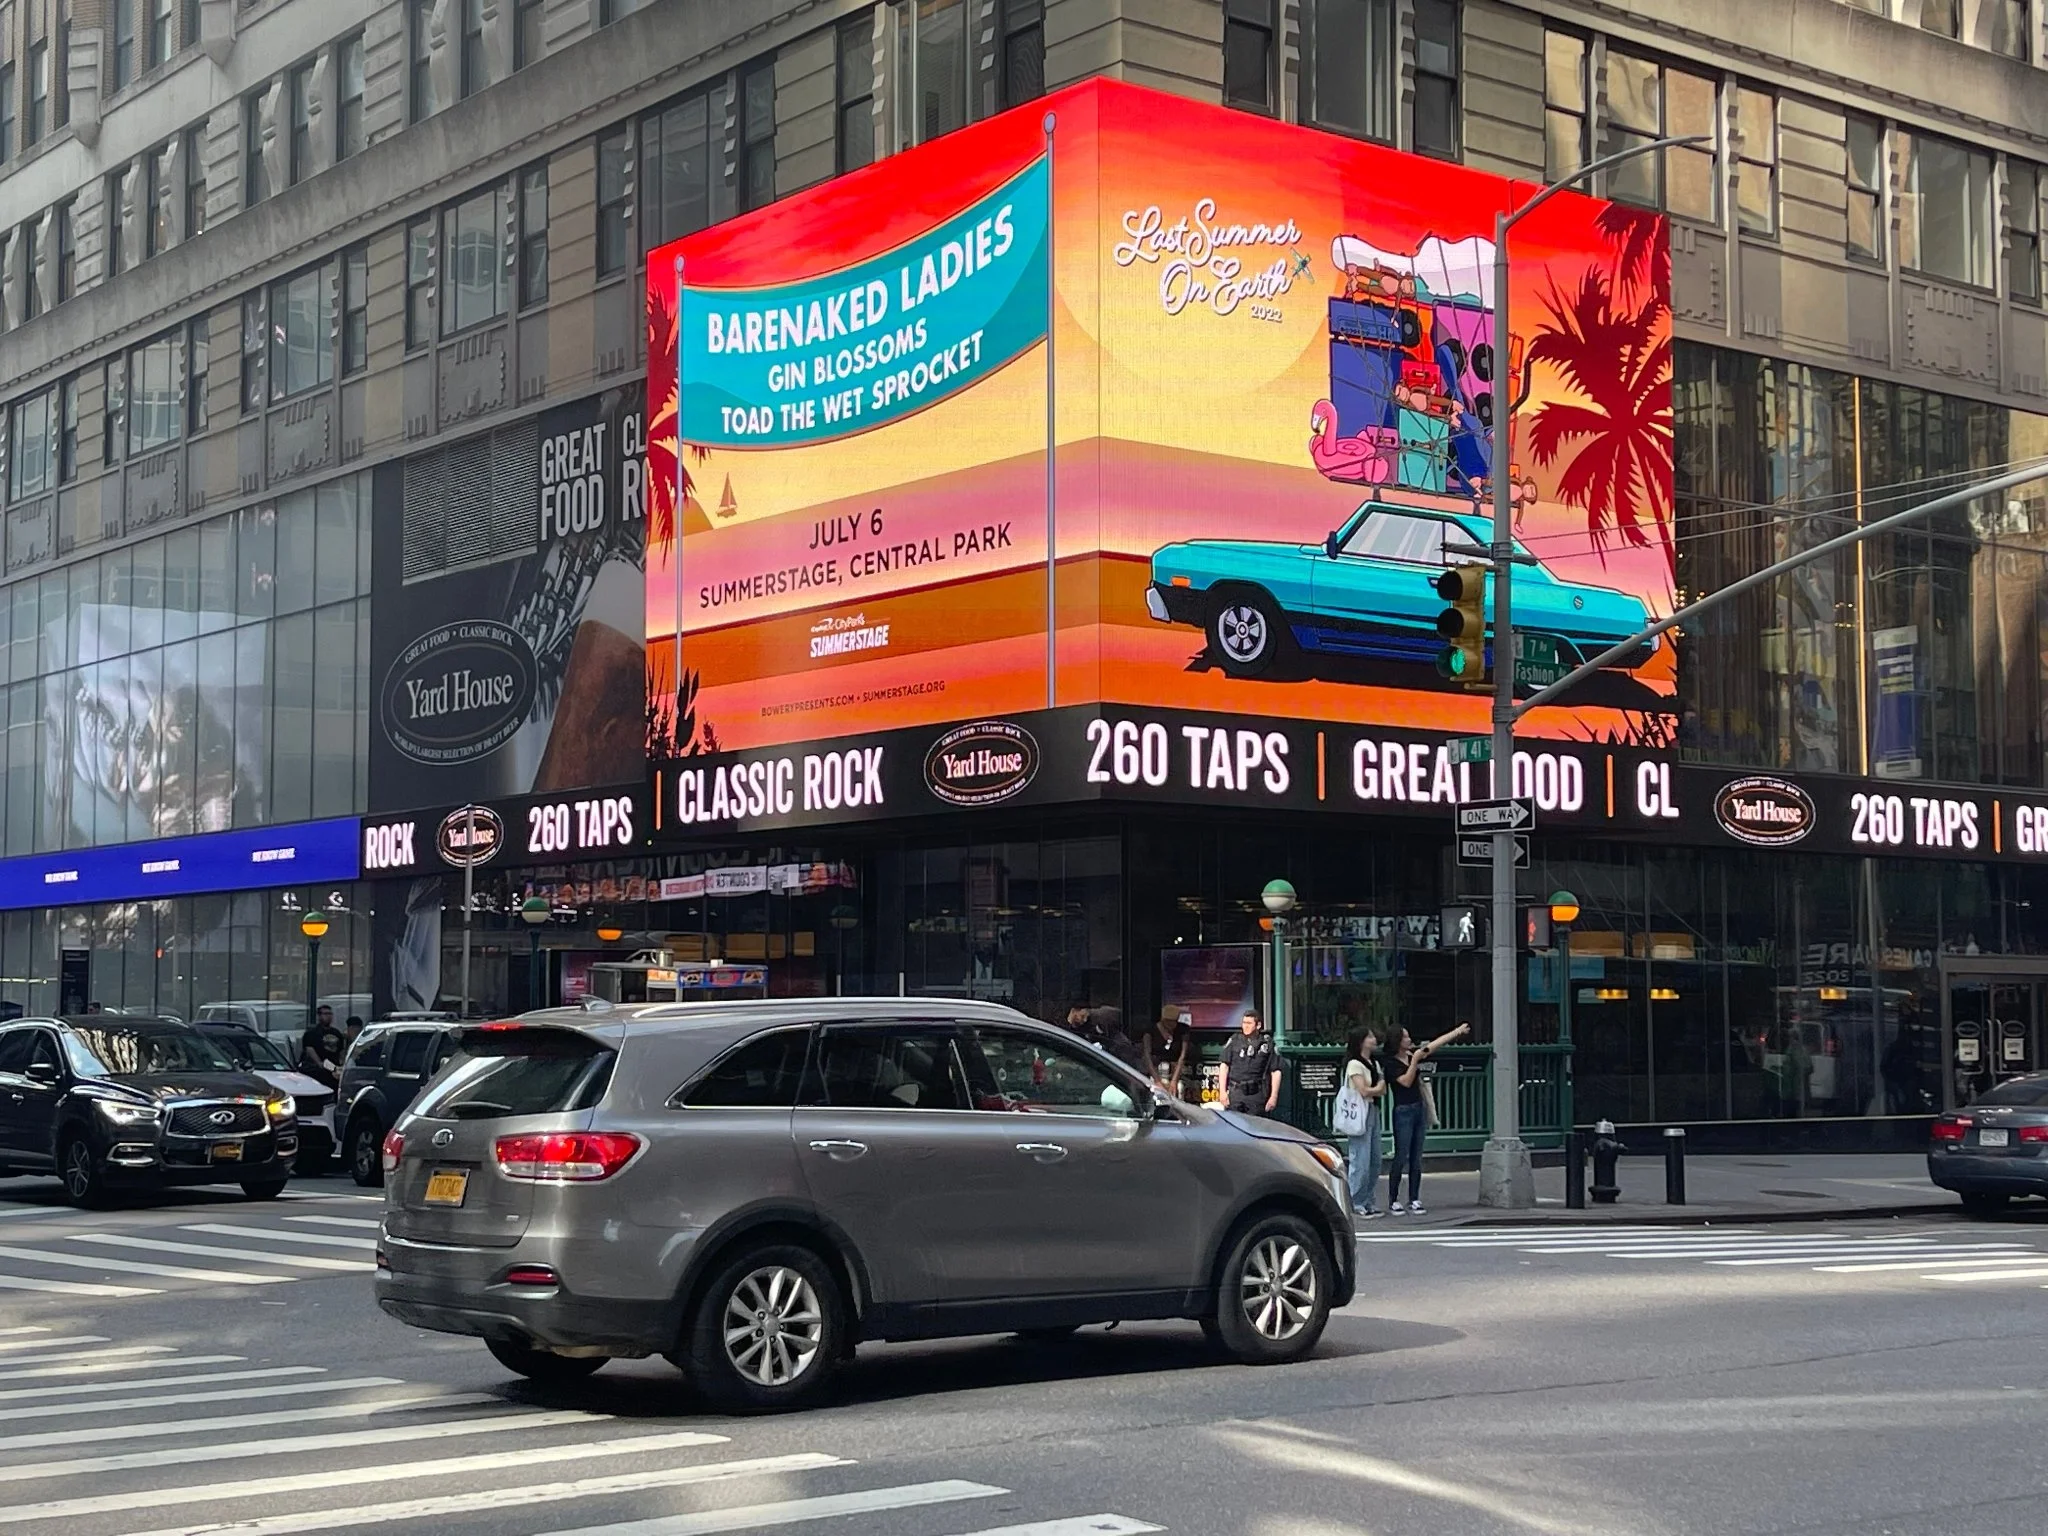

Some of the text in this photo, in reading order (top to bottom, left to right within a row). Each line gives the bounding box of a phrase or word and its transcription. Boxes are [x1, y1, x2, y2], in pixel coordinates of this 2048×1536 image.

[1113, 198, 1302, 267] Last Summer
[707, 204, 1015, 354] BARENAKED LADIES
[1160, 255, 1293, 315] On Earth
[1251, 305, 1283, 323] 2022
[767, 318, 927, 392] GIN BLOSSOMS
[721, 329, 984, 436] TOAD THE WET SPROCKET
[541, 423, 606, 485] GREAT
[541, 474, 605, 541] FOOD
[809, 508, 883, 550] JULY 6
[700, 521, 1012, 608] SUMMERSTAGE, CENTRAL PARK
[429, 630, 450, 648] FOOD
[459, 626, 491, 639] CLASSIC
[809, 624, 890, 658] SUMMERSTAGE
[1529, 639, 1537, 657] 7
[406, 669, 515, 719] Yard House
[1515, 661, 1554, 683] Fashion
[761, 680, 946, 717] BOWERYPRESENTS.COM SUMMERSTAGE.ORG
[943, 749, 1023, 779] Yard House
[1086, 718, 1290, 794] 260 TAPS
[1470, 740, 1481, 759] 41
[678, 747, 884, 824] CLASSIC ROCK
[1489, 751, 1584, 811] OOD
[528, 796, 633, 853] 260 TAPS
[1466, 807, 1521, 823] ONE WAY
[1731, 799, 1802, 823] Yard House
[1851, 793, 1979, 849] 260 TAPS
[365, 821, 416, 869] ROCK
[448, 827, 467, 847] Yard
[1467, 843, 1488, 856] ONE
